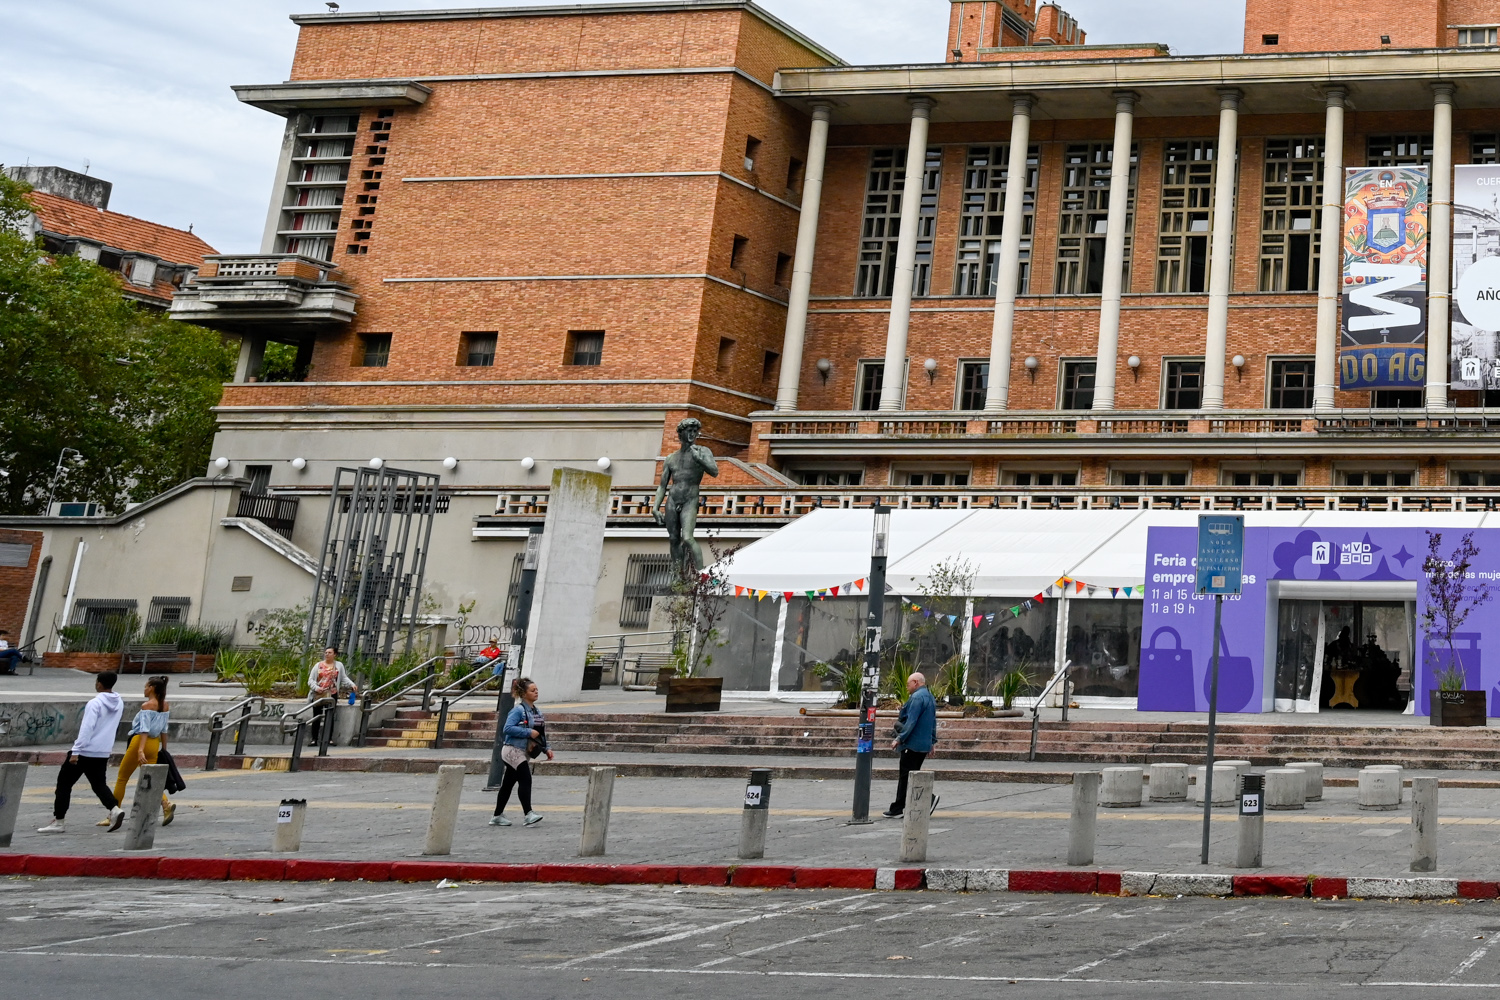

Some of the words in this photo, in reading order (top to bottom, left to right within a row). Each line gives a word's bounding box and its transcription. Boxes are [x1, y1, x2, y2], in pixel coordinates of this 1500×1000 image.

[1379, 179, 1393, 188] EN
[1341, 353, 1378, 384] DO
[1388, 352, 1425, 382] AG
[1342, 543, 1371, 552] MVD
[1153, 553, 1187, 567] Feria
[1152, 589, 1160, 600] 11
[1163, 589, 1173, 600] al
[1177, 589, 1187, 600] 15
[1151, 603, 1159, 613] 11
[1162, 605, 1169, 614] a
[1173, 603, 1184, 614] 19
[1188, 603, 1195, 614] h
[1243, 799, 1258, 807] 623
